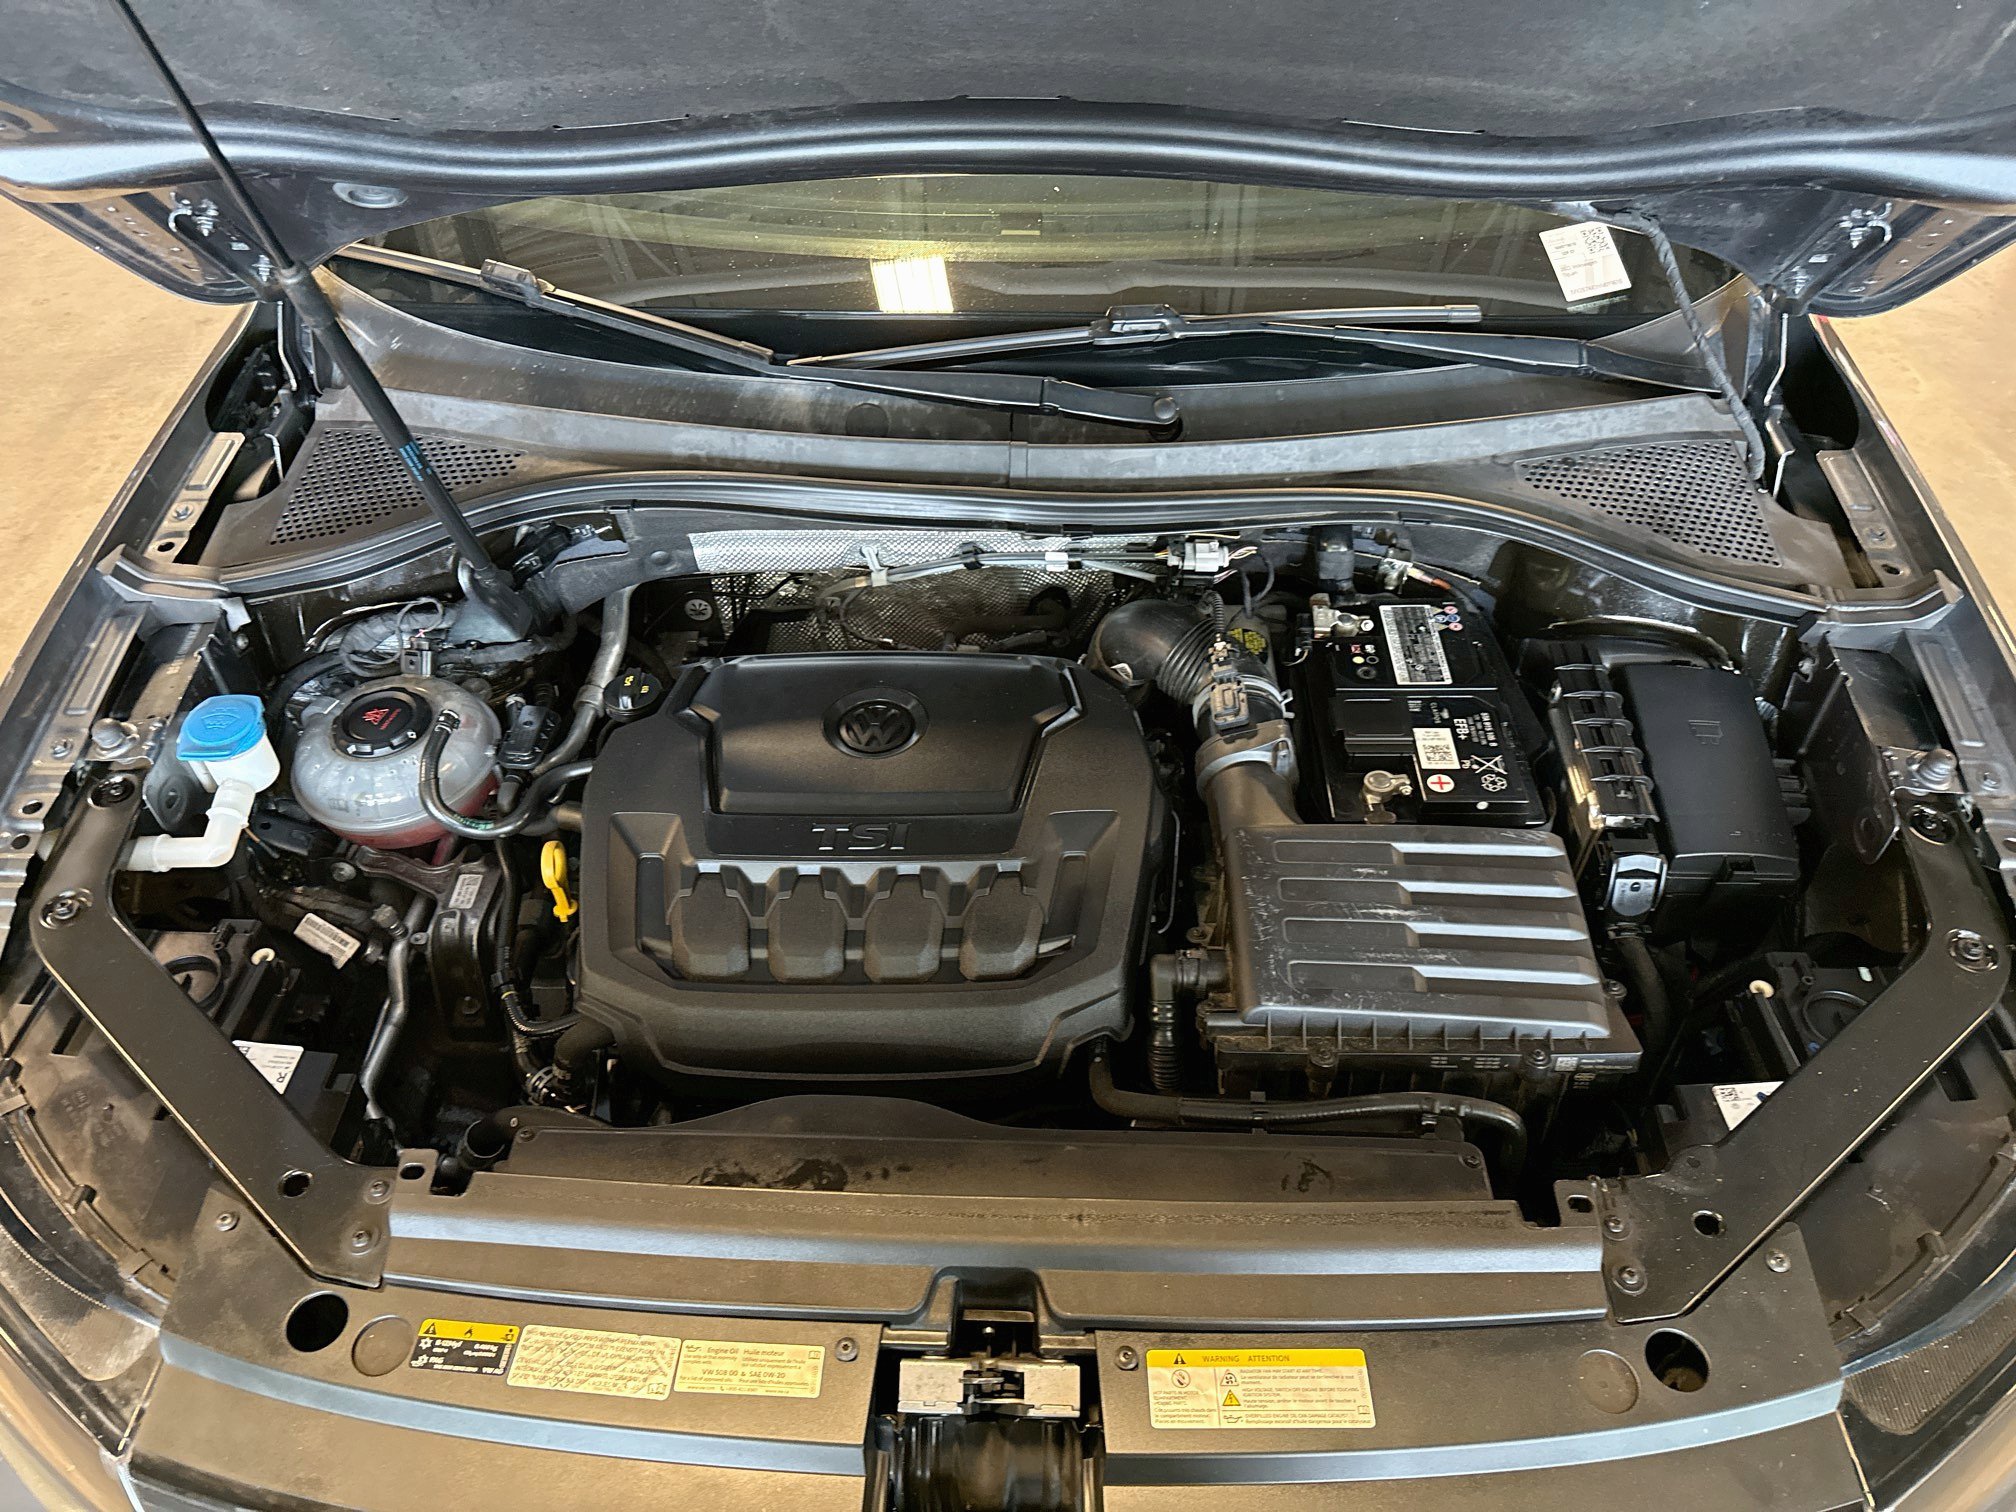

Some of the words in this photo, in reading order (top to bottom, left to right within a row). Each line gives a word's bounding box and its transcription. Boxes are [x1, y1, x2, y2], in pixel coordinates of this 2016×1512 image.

[1453, 718, 1470, 740] EFB+
[812, 823, 911, 851] TSI
[707, 1347, 729, 1356] Engine
[744, 1348, 760, 1356] Huile
[1202, 1354, 1240, 1363] WARNING
[1248, 1354, 1290, 1362] ATTENTION
